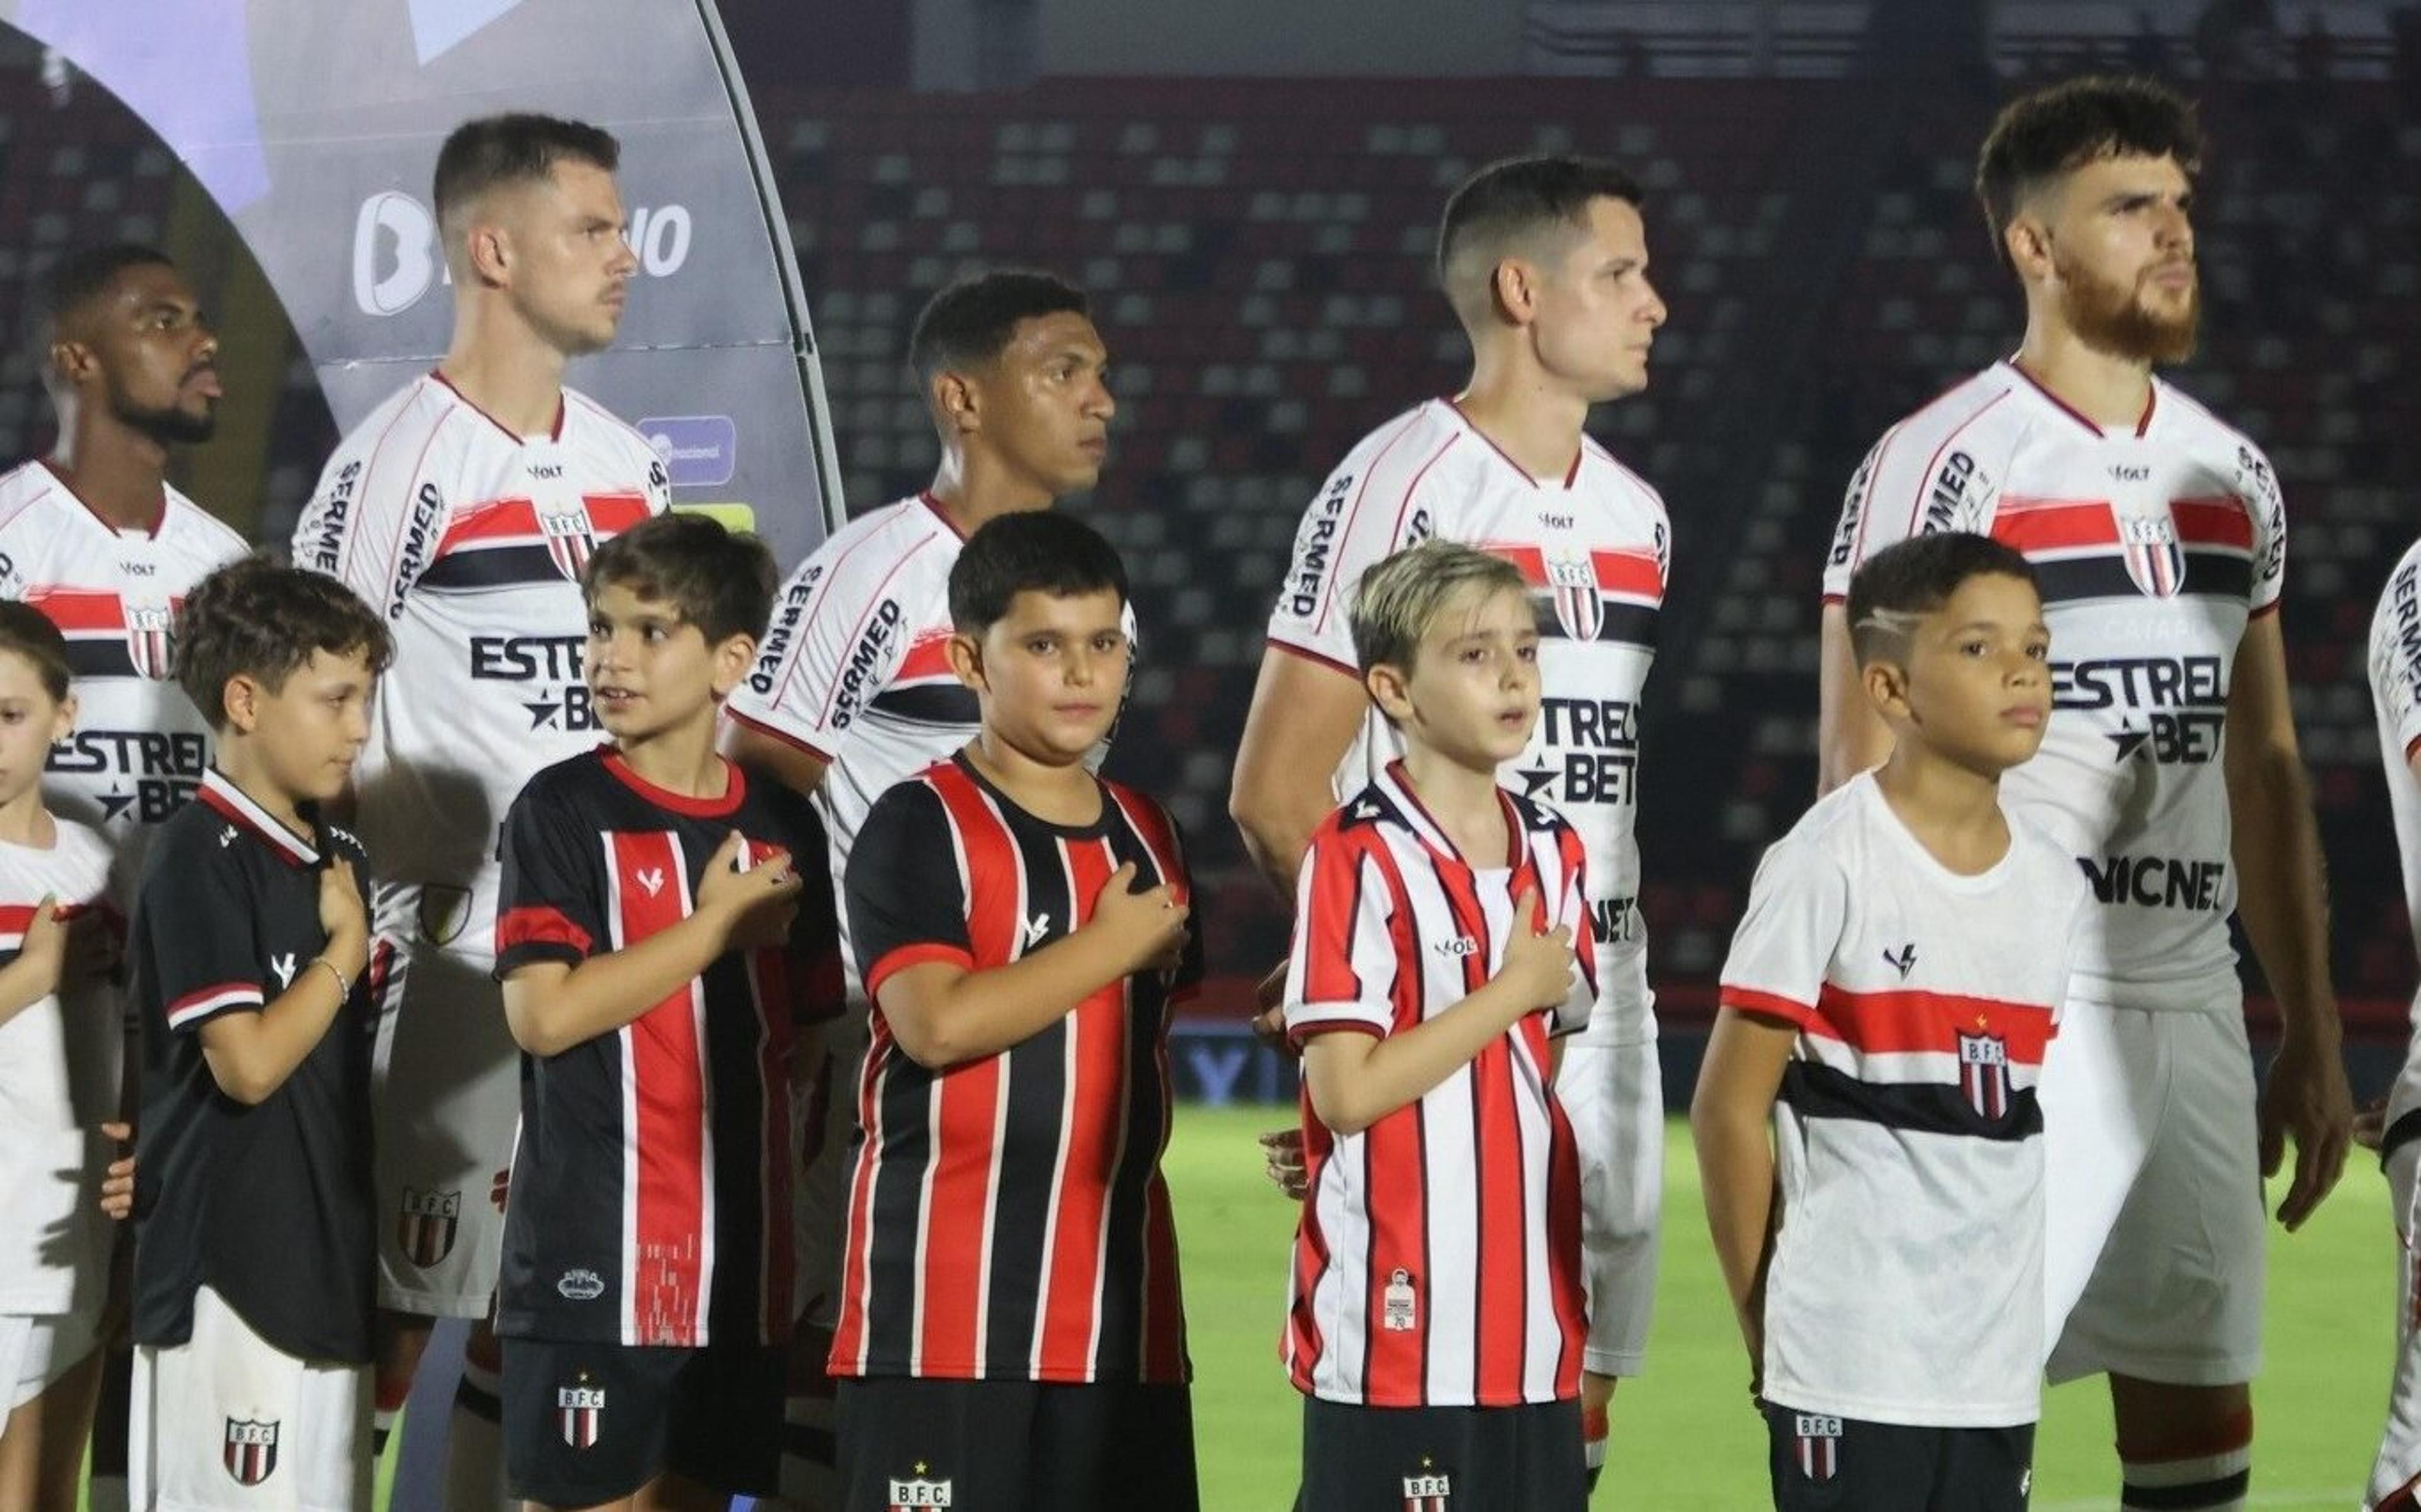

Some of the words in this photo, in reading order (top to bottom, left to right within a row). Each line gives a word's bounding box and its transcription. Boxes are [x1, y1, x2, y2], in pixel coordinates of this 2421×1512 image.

[527, 464, 562, 480] VOLT
[1293, 476, 1354, 614] SERMED
[120, 562, 156, 576] VOLT
[832, 599, 900, 729] SERMED
[1564, 753, 1636, 805] BET
[898, 1486, 948, 1503] B.F.C.
